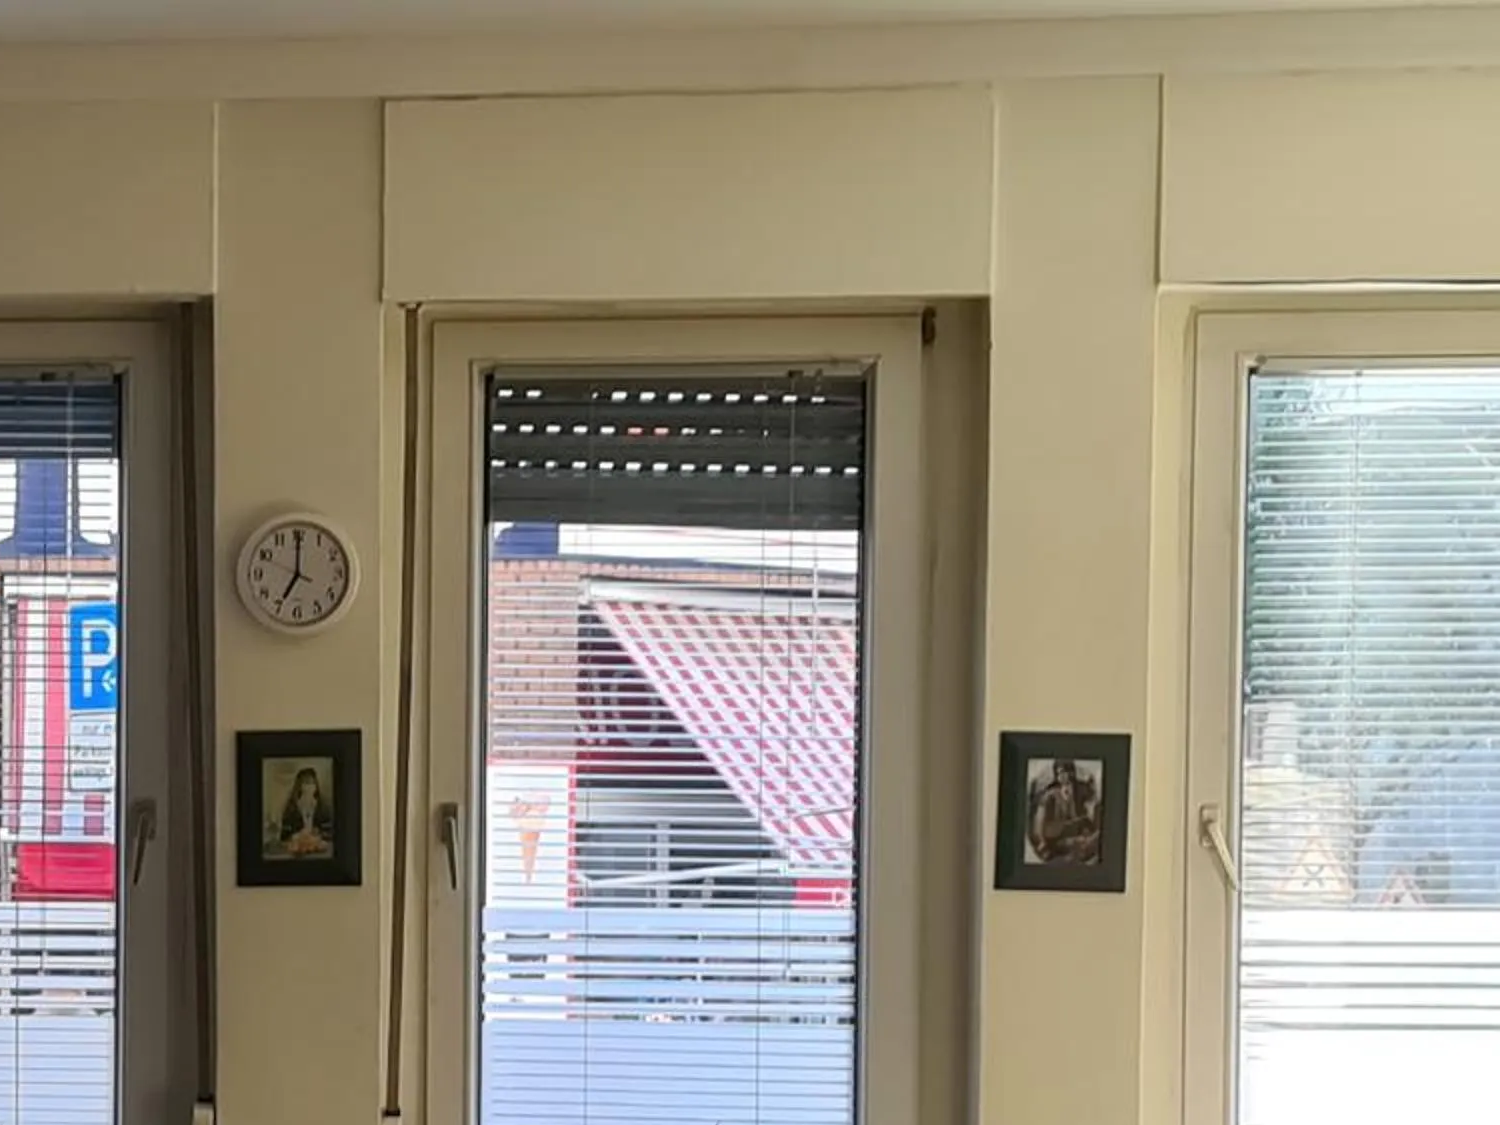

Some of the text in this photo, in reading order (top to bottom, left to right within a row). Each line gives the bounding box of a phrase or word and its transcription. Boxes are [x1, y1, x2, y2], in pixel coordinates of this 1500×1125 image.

[274, 533, 285, 546] 11
[260, 548, 273, 561] 10
[253, 567, 263, 582] 9
[274, 599, 283, 614] 7
[291, 605, 302, 620] 6
[82, 619, 117, 699] P
